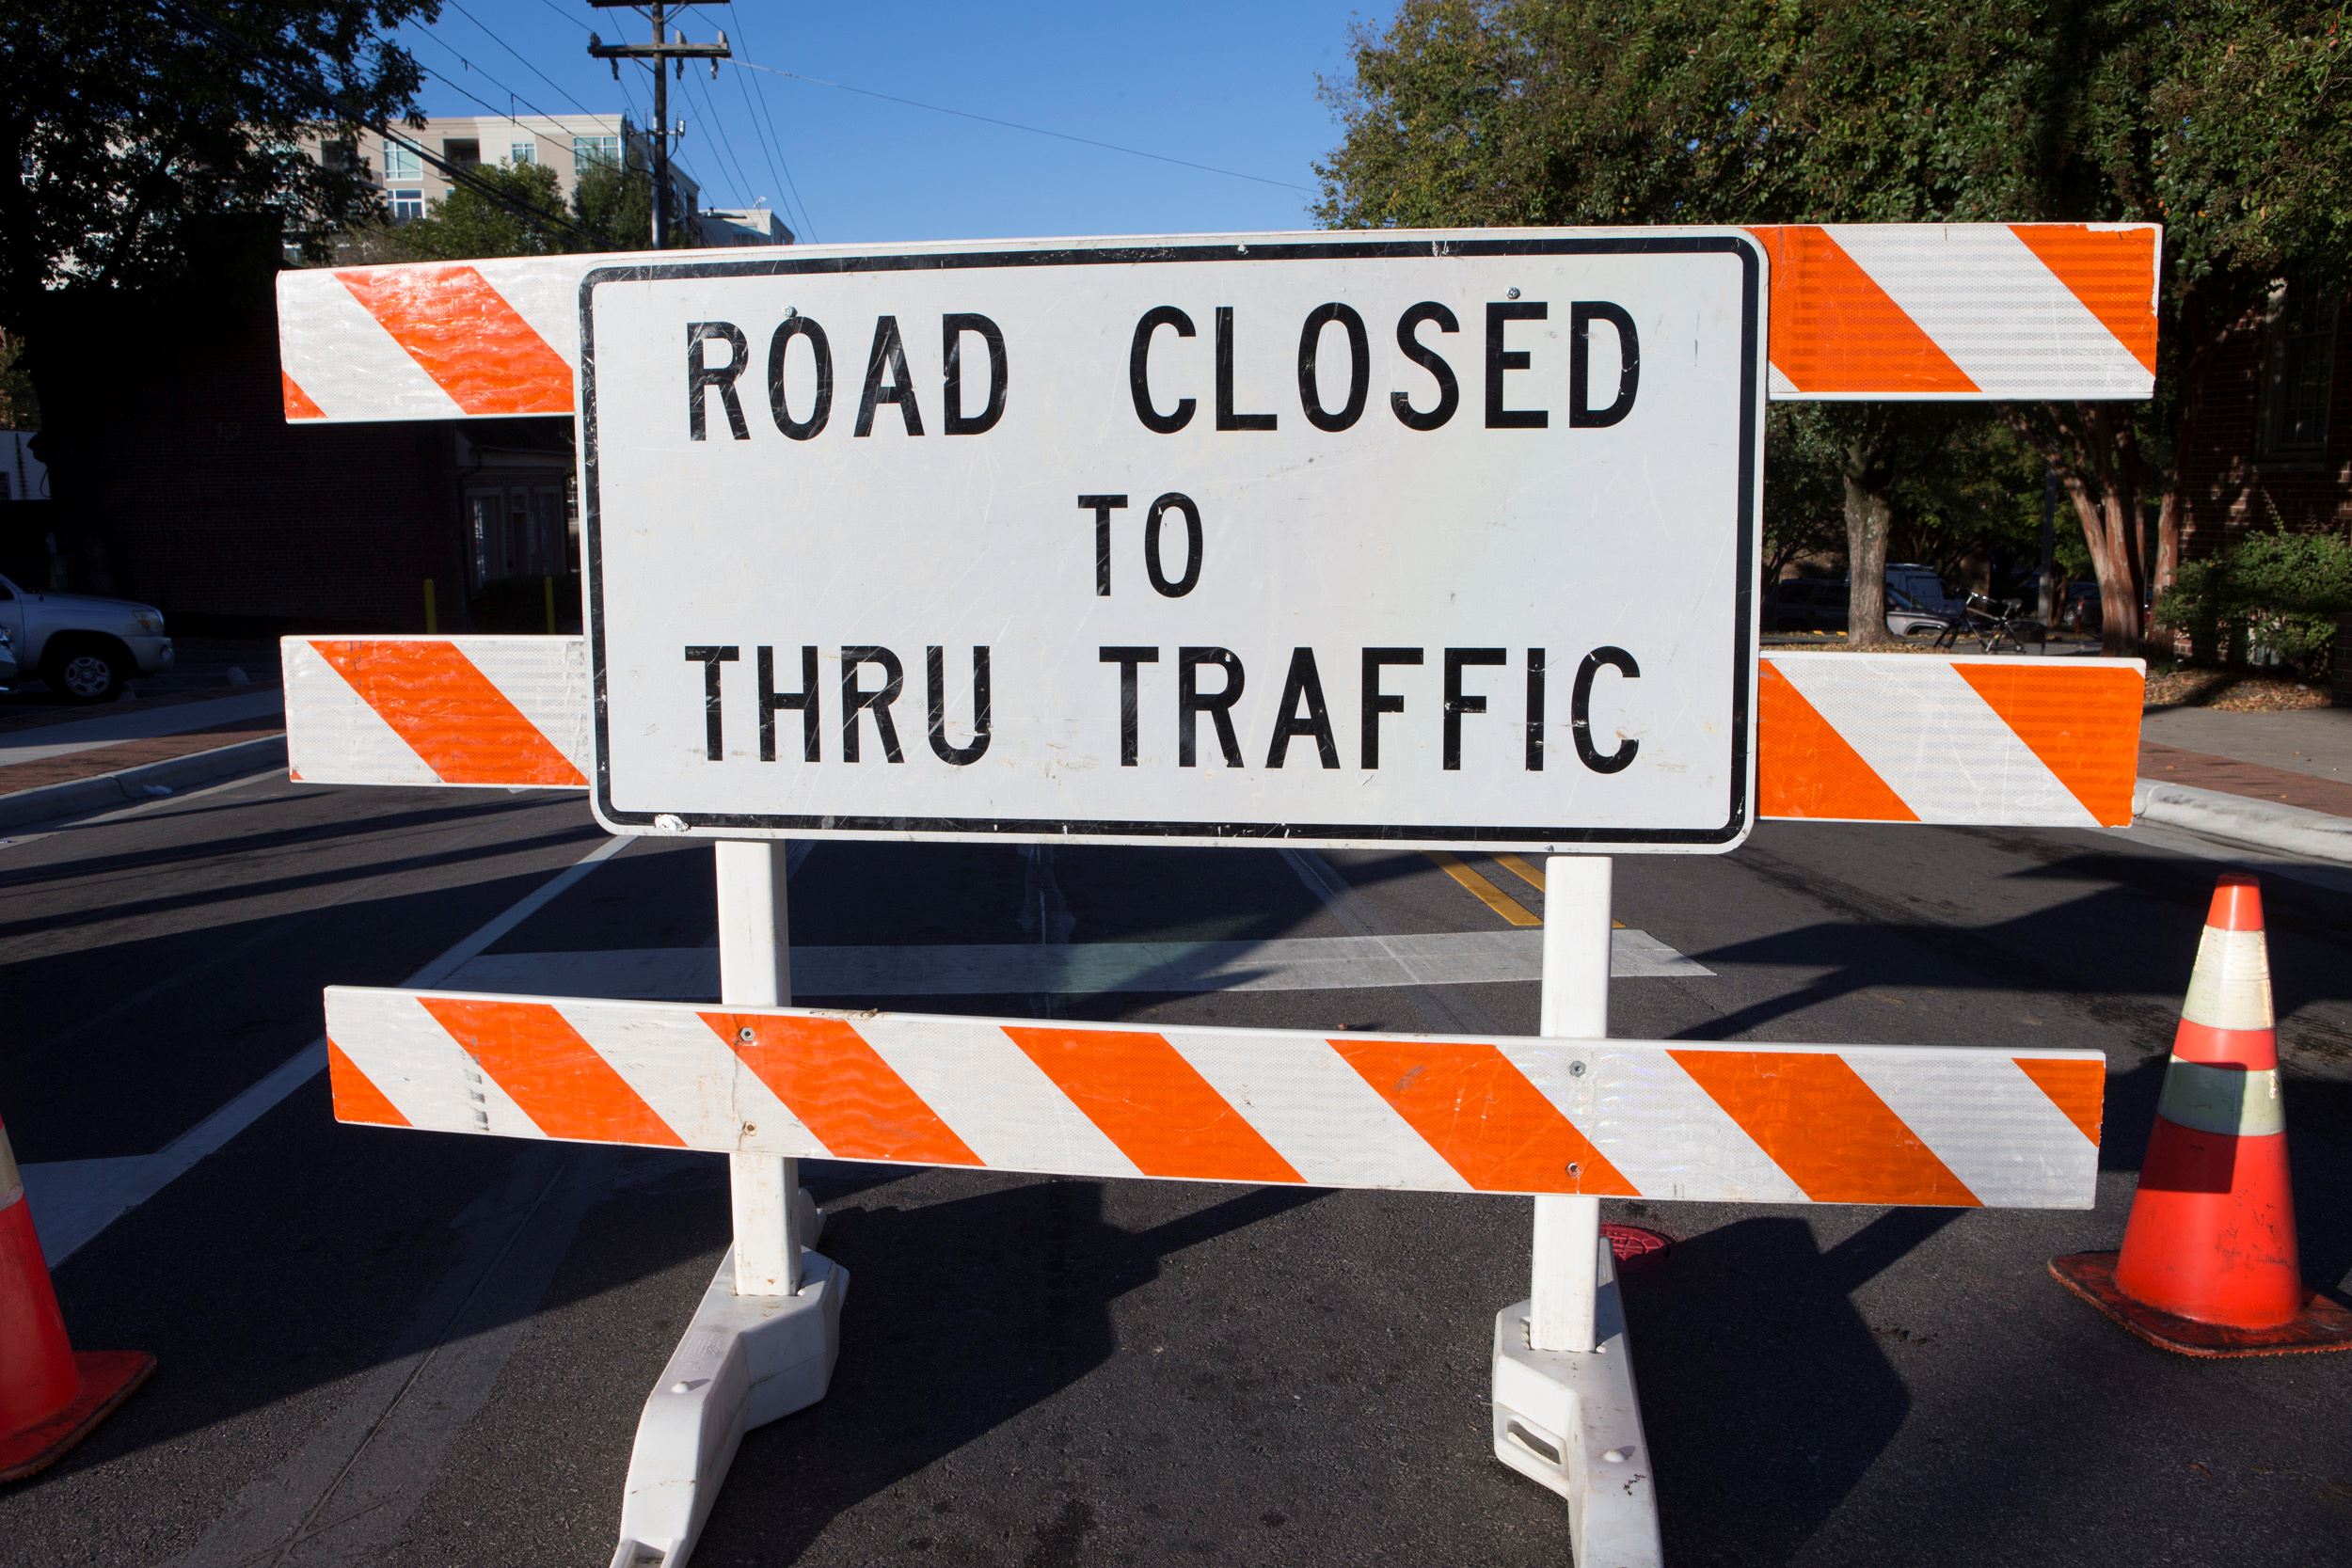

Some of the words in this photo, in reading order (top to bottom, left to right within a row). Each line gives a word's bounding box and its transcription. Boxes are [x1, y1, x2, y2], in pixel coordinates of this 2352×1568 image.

[689, 313, 1008, 440] ROAD
[1130, 301, 1640, 434] CLOSED
[1078, 492, 1202, 597] TO
[685, 646, 991, 766] THRU
[1100, 646, 1640, 774] TRAFFIC
